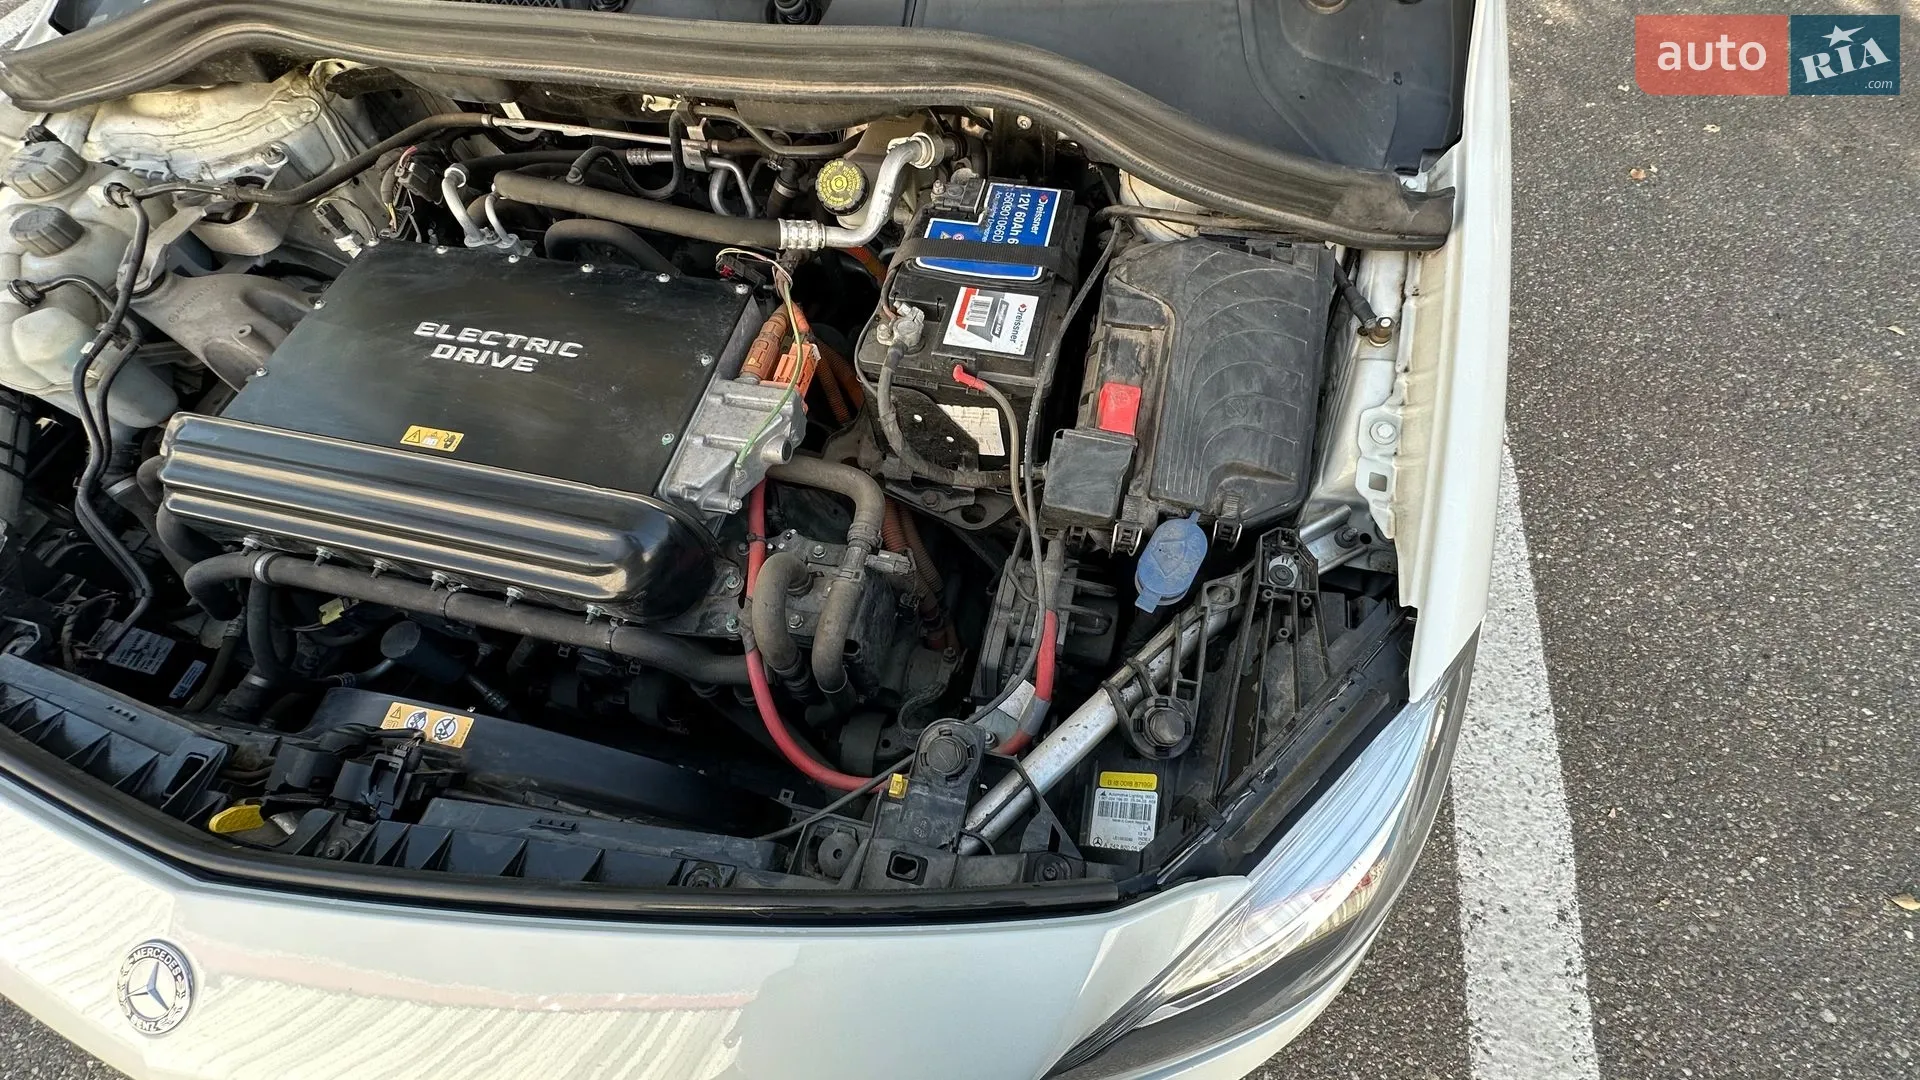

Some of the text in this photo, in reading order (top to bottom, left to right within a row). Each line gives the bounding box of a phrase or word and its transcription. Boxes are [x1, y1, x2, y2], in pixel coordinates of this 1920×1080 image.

[1017, 193, 1031, 210] 12V
[1009, 211, 1026, 236] 60Ah
[1030, 198, 1049, 235] Dreissner
[413, 321, 584, 358] ELECTRIC
[1010, 307, 1026, 343] Dreissner
[430, 343, 539, 373] DRIVE
[132, 947, 183, 976] MERCEDES
[130, 1015, 159, 1032] BENZ
